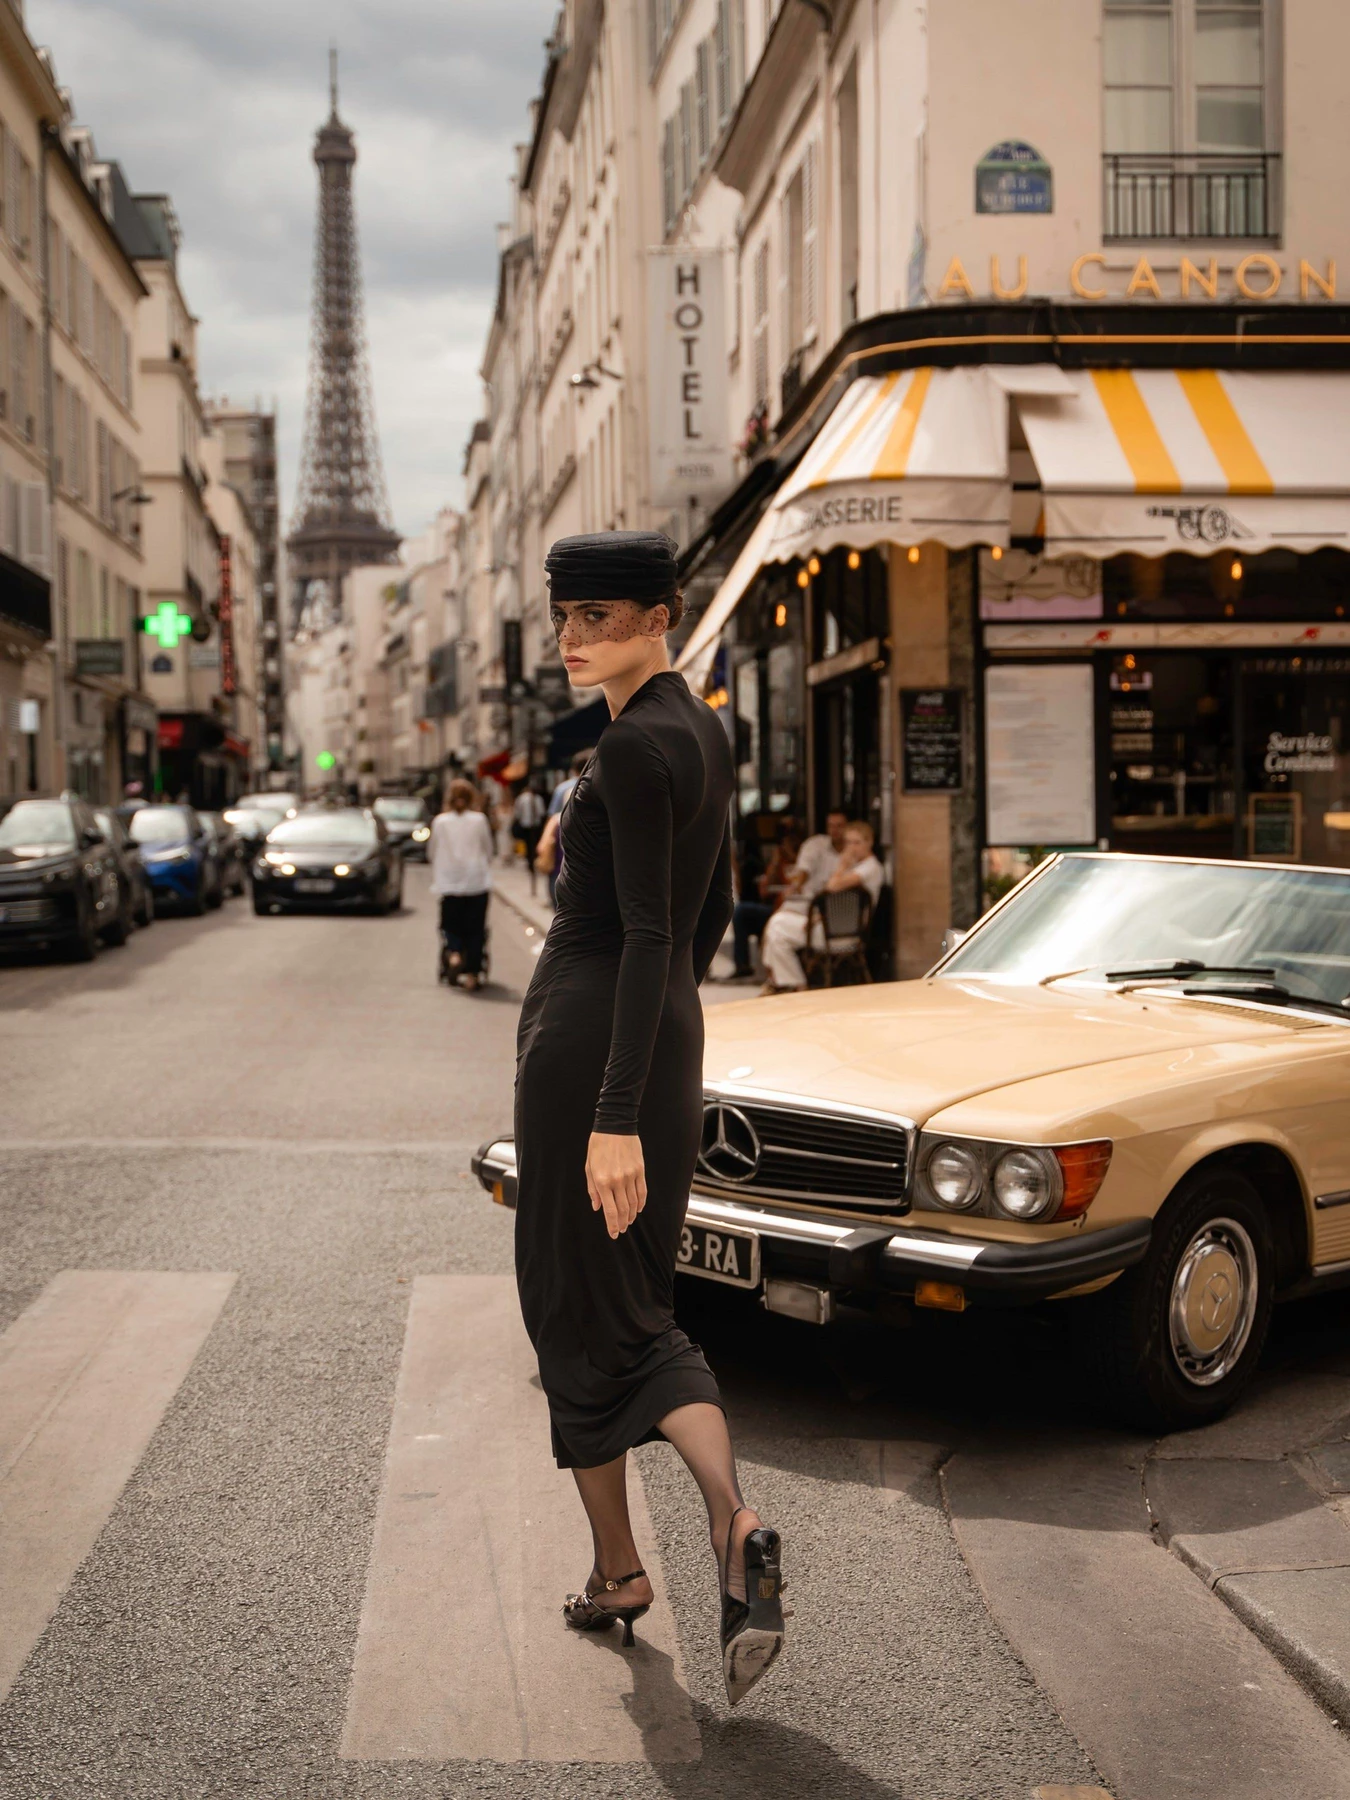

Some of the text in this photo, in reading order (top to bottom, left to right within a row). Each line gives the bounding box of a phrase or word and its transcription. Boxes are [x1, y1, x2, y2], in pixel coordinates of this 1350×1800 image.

[939, 253, 1337, 300] AU CANON
[675, 263, 703, 440] HOTEL
